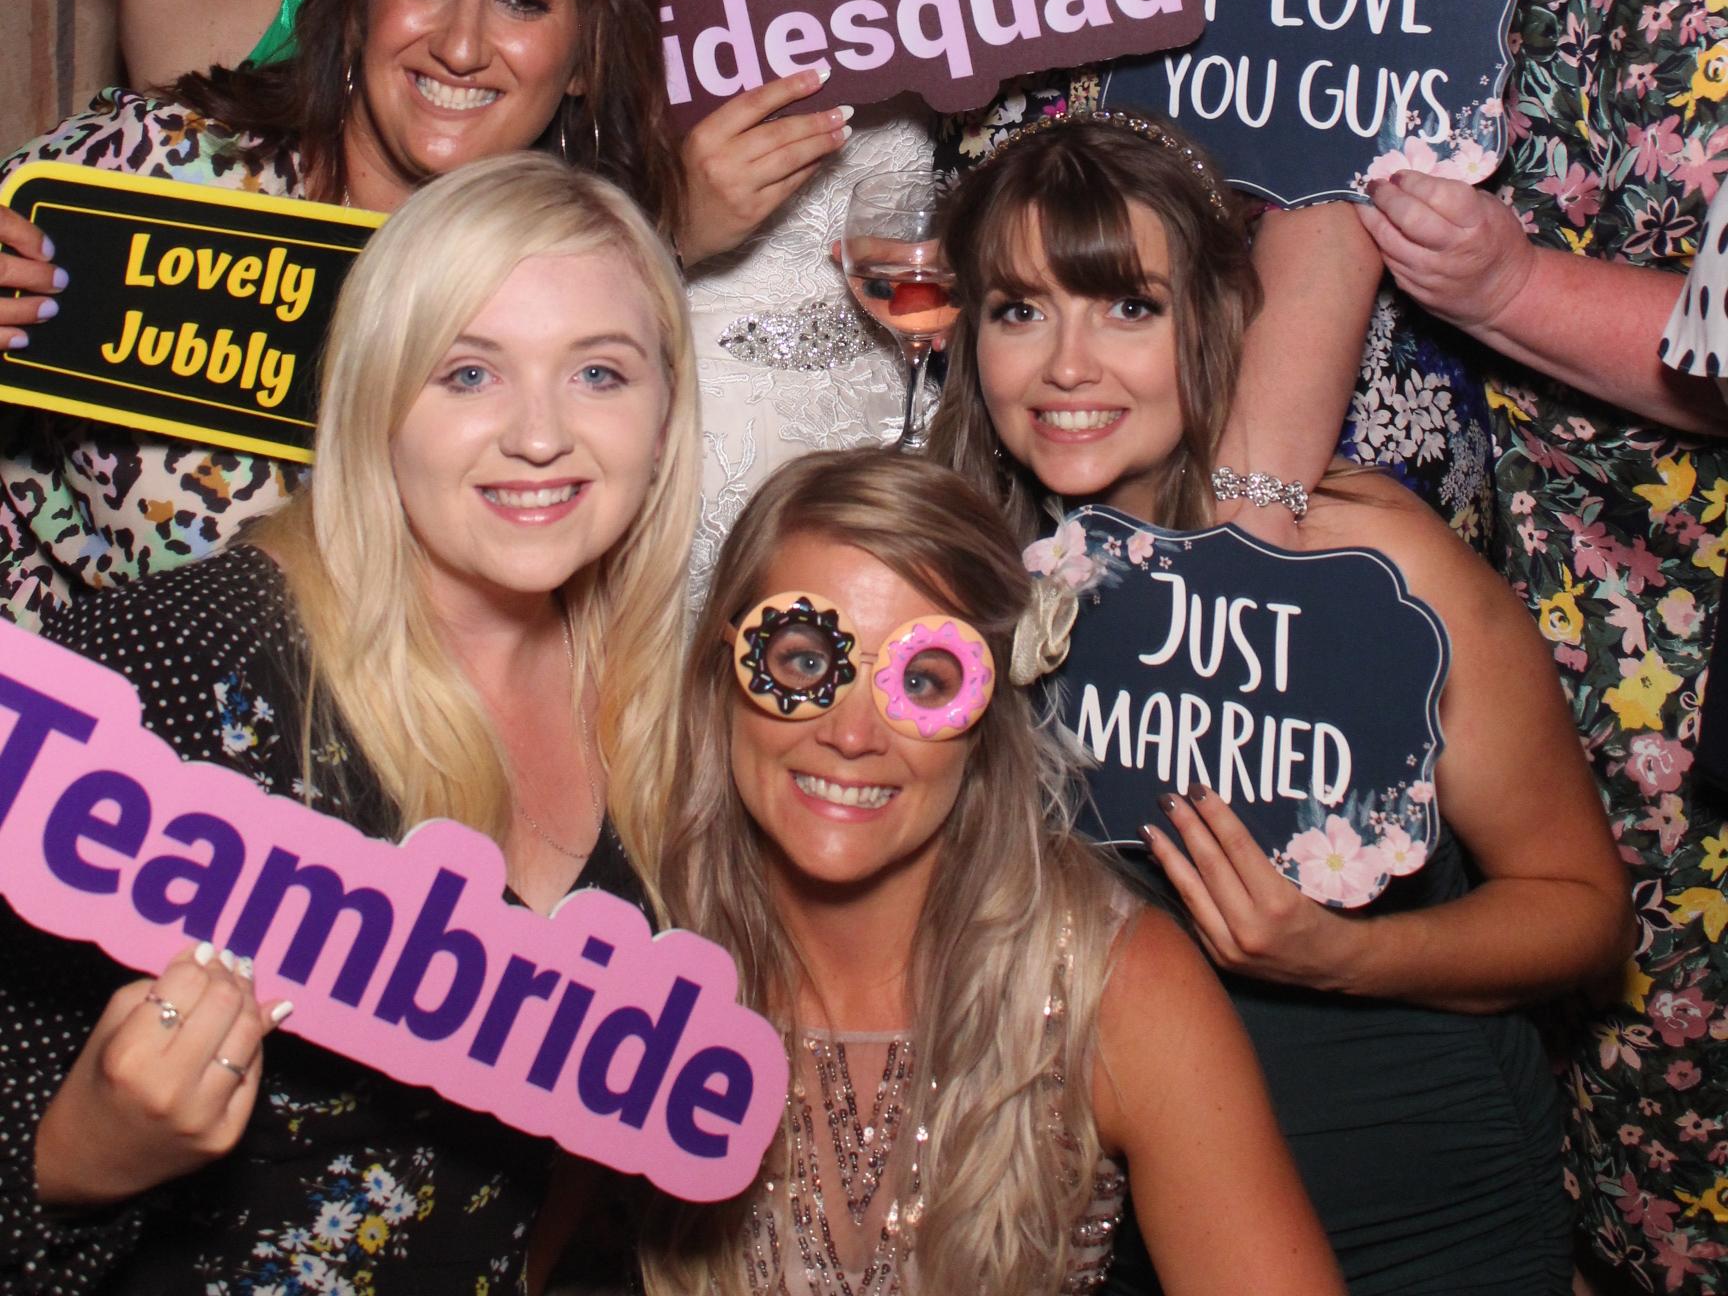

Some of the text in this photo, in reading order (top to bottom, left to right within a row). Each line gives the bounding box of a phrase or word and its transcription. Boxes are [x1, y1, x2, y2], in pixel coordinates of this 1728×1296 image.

[1164, 52, 1451, 144] YOU GUYS
[124, 232, 316, 323] Lovely
[100, 310, 297, 408] Jubbly
[1138, 571, 1302, 693] JUST
[1076, 682, 1353, 805] MARRIED
[0, 672, 755, 1159] Teambride
